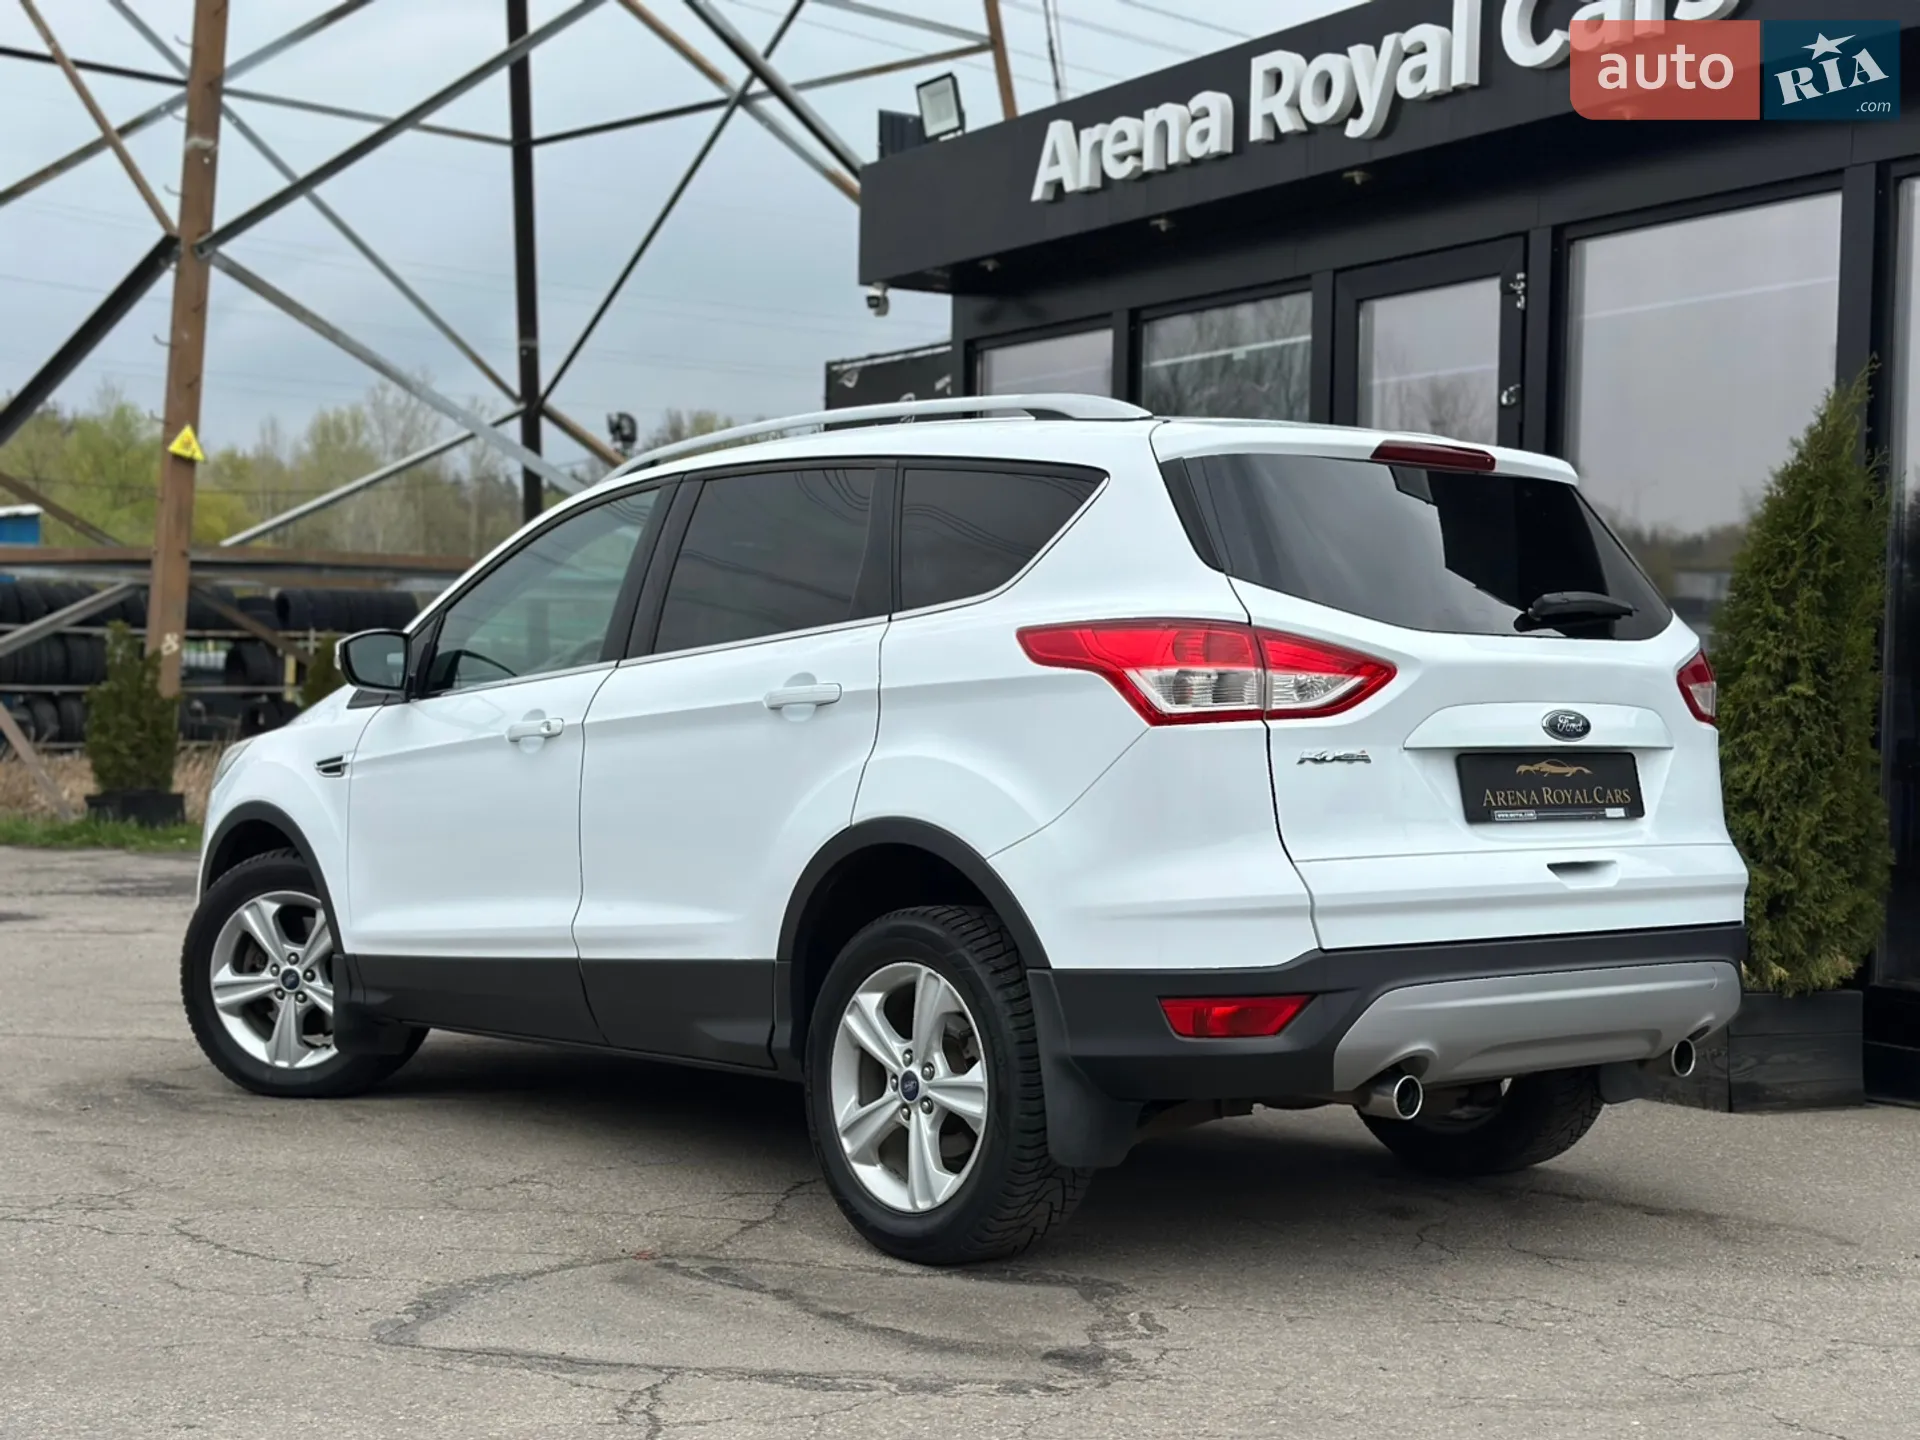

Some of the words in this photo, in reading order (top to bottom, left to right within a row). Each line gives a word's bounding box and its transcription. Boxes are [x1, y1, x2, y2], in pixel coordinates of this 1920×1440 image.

[1031, 90, 1234, 202] Arena
[1249, 0, 1482, 143] Royal
[1501, 0, 1738, 68] Ca
[1557, 714, 1584, 732] Ford
[1482, 788, 1540, 807] ARENA
[1541, 786, 1592, 805] ROYAL
[1593, 786, 1632, 804] CARS
